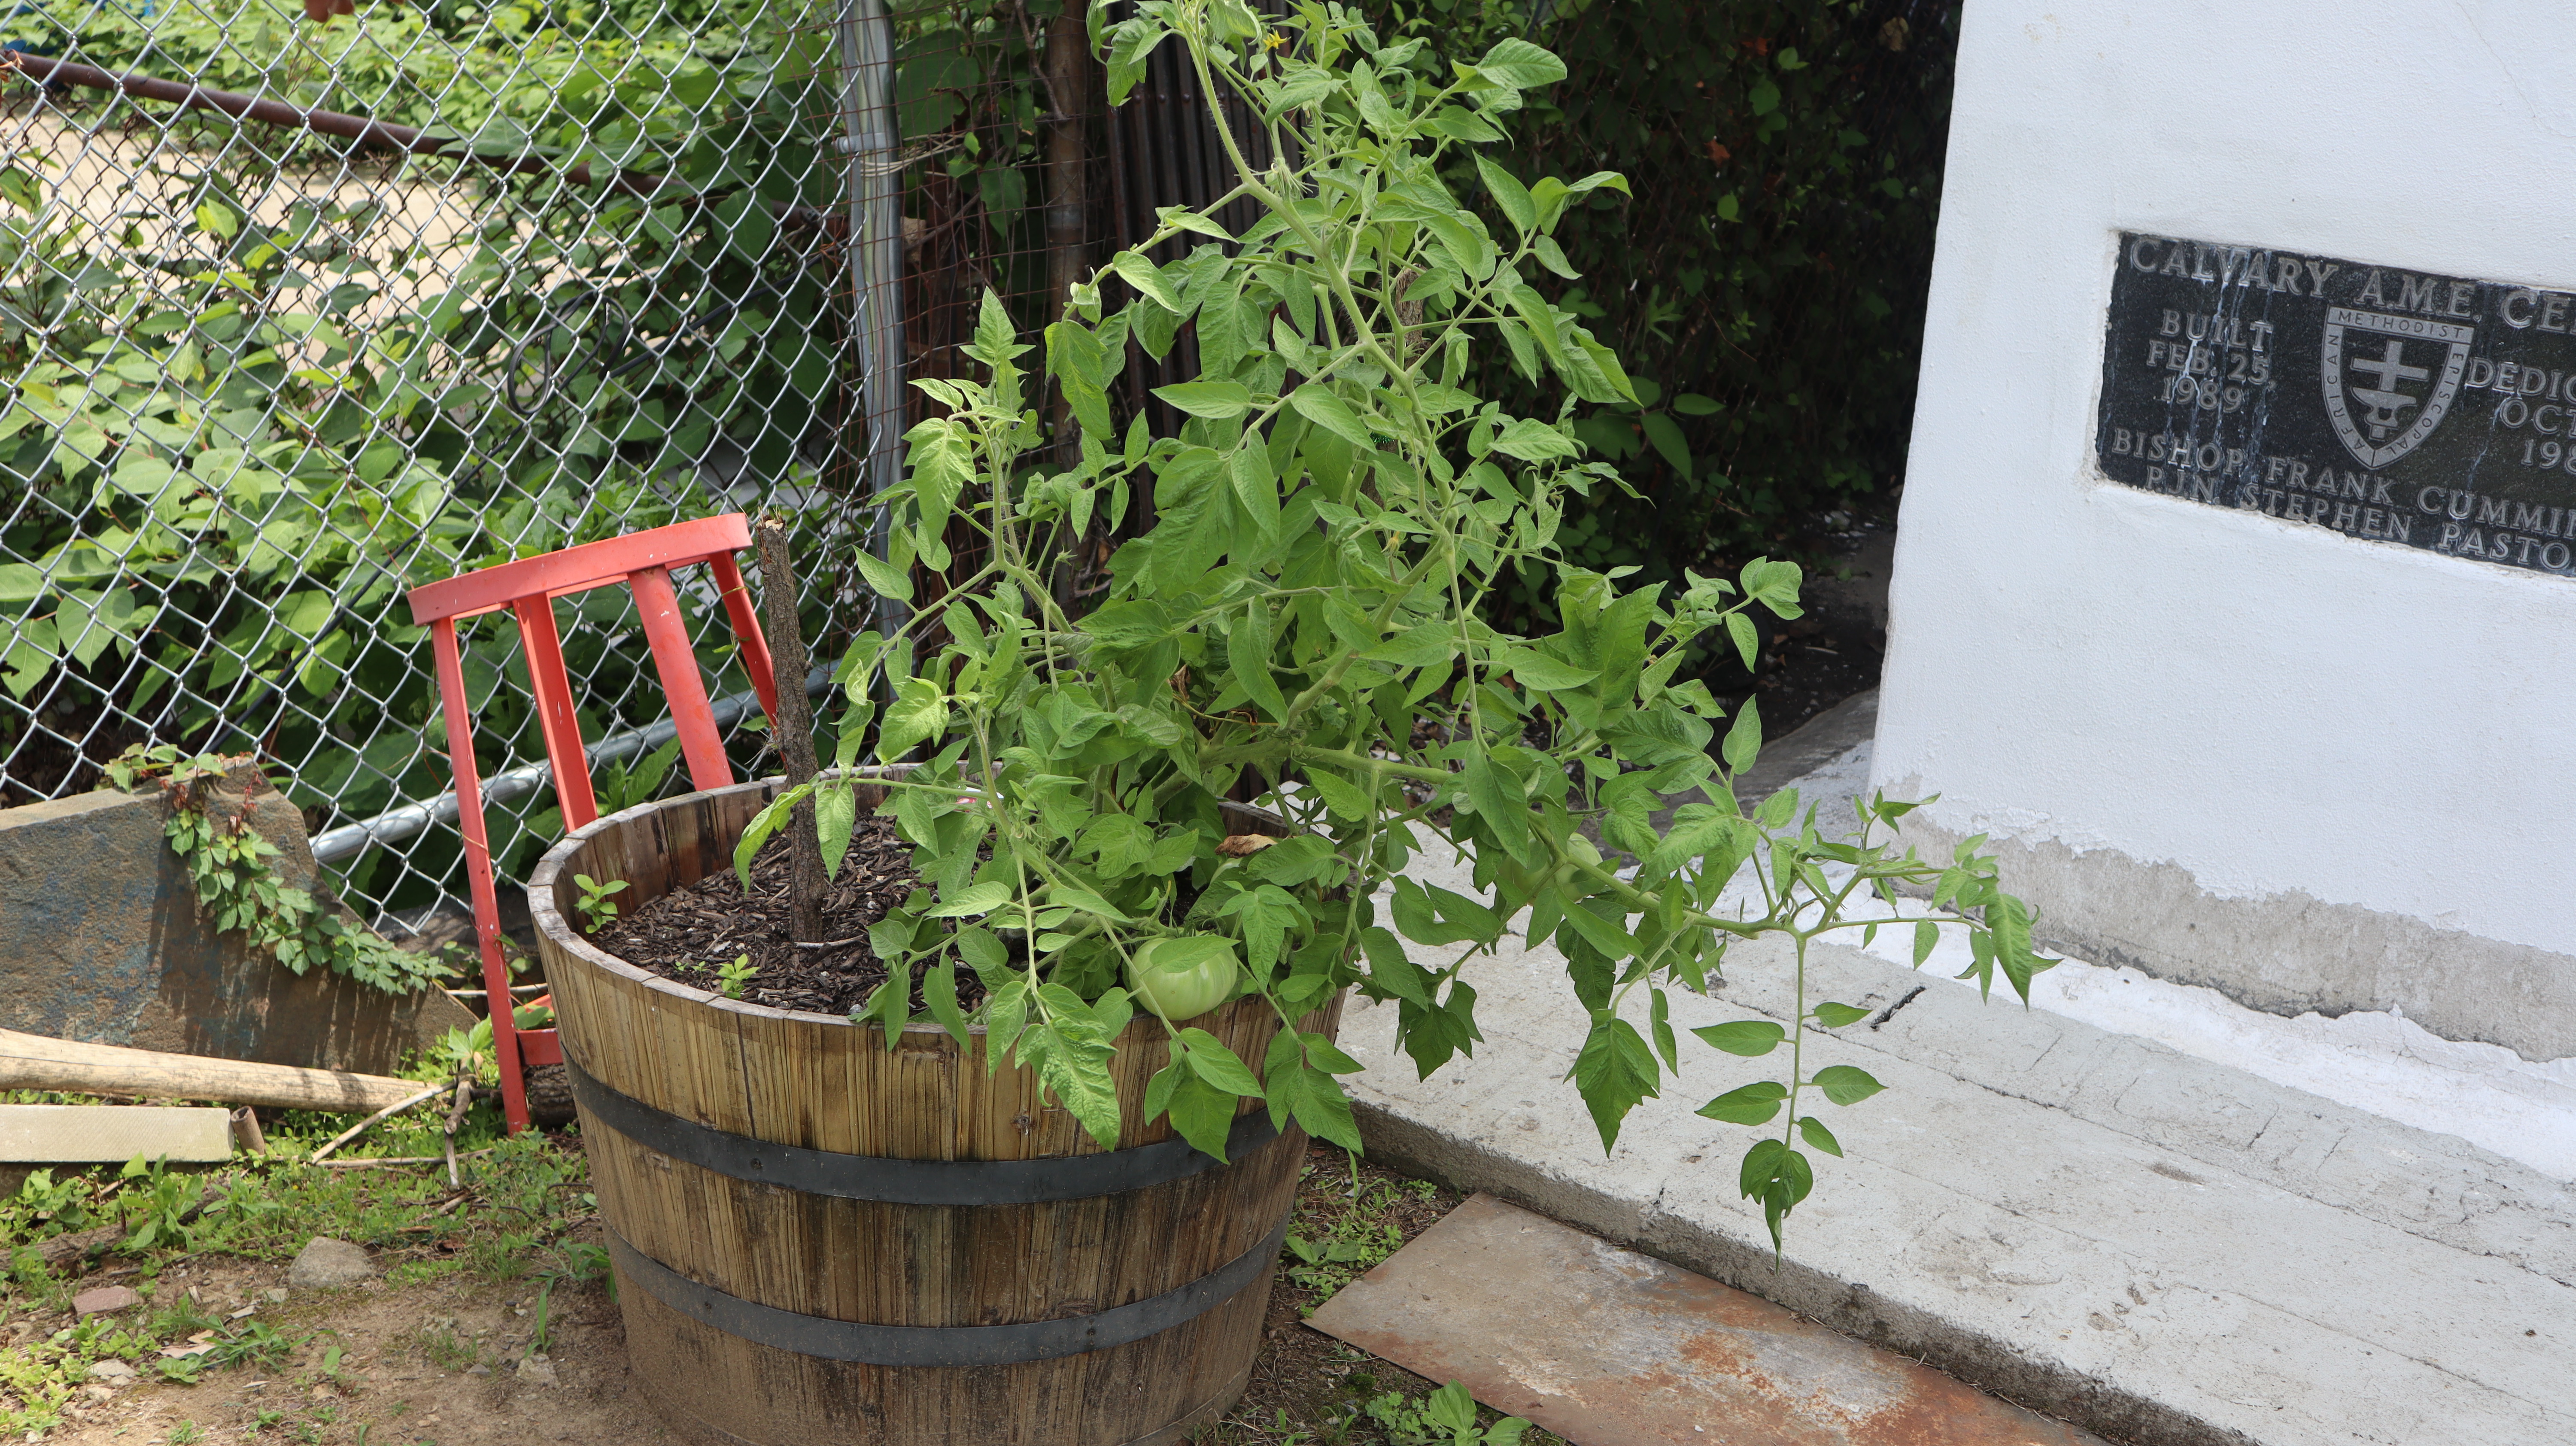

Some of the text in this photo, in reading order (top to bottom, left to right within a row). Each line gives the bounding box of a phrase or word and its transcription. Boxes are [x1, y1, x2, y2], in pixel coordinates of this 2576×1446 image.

[2130, 238, 2576, 335] CALVARY A.M.E. CE
[2338, 311, 2464, 338] METHODIST
[2147, 340, 2218, 377] FEB.
[2160, 308, 2273, 352] BUILT
[2161, 374, 2243, 413] 1989
[2327, 334, 2366, 450] AFRICAN
[2385, 352, 2464, 455] EPISCOPAL
[2111, 428, 2246, 475] BISHOP
[2265, 455, 2397, 506] FRANK
[2240, 483, 2411, 542] STEPHEN
[2438, 521, 2576, 571] PASTO
